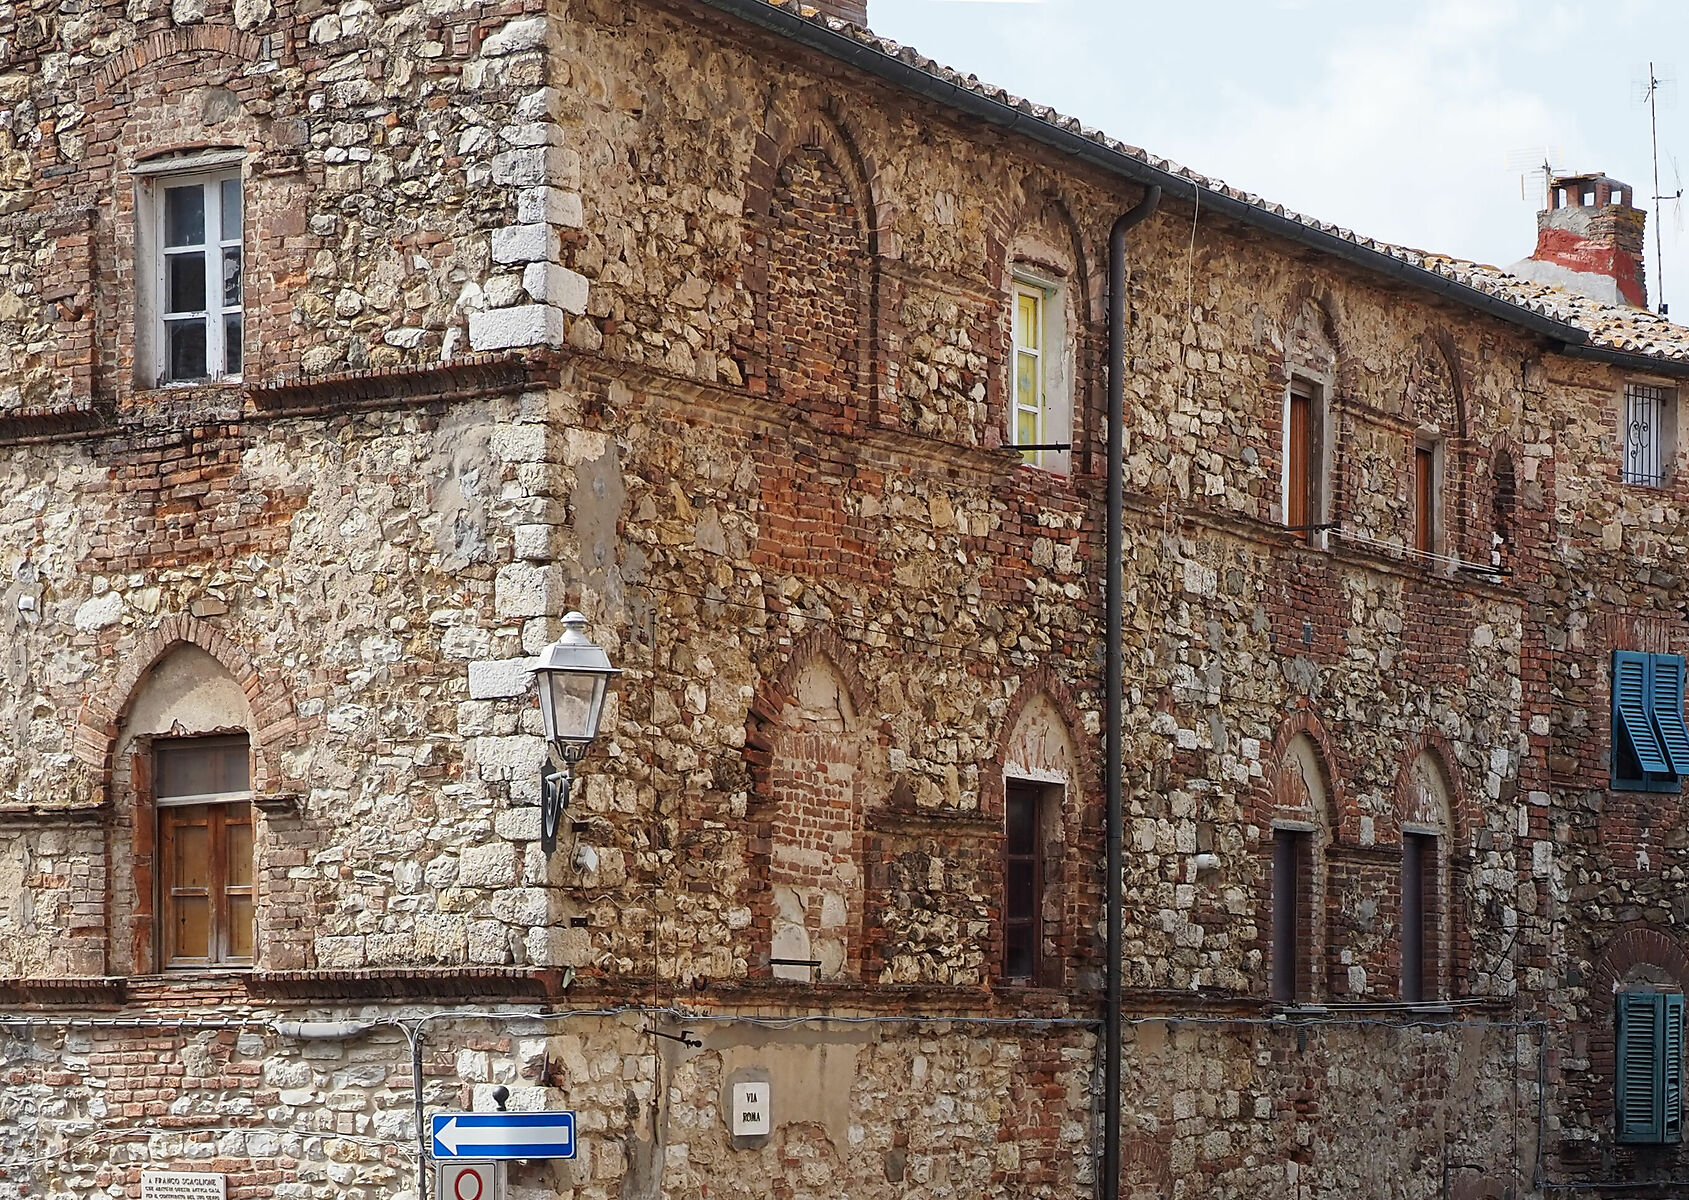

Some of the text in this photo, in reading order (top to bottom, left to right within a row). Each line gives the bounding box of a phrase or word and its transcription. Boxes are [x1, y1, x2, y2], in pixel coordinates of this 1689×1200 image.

[746, 1092, 758, 1103] VIA
[742, 1111, 761, 1123] ROMA
[154, 1177, 180, 1185] FRANCO
[181, 1178, 217, 1186] SCAGLIONE
